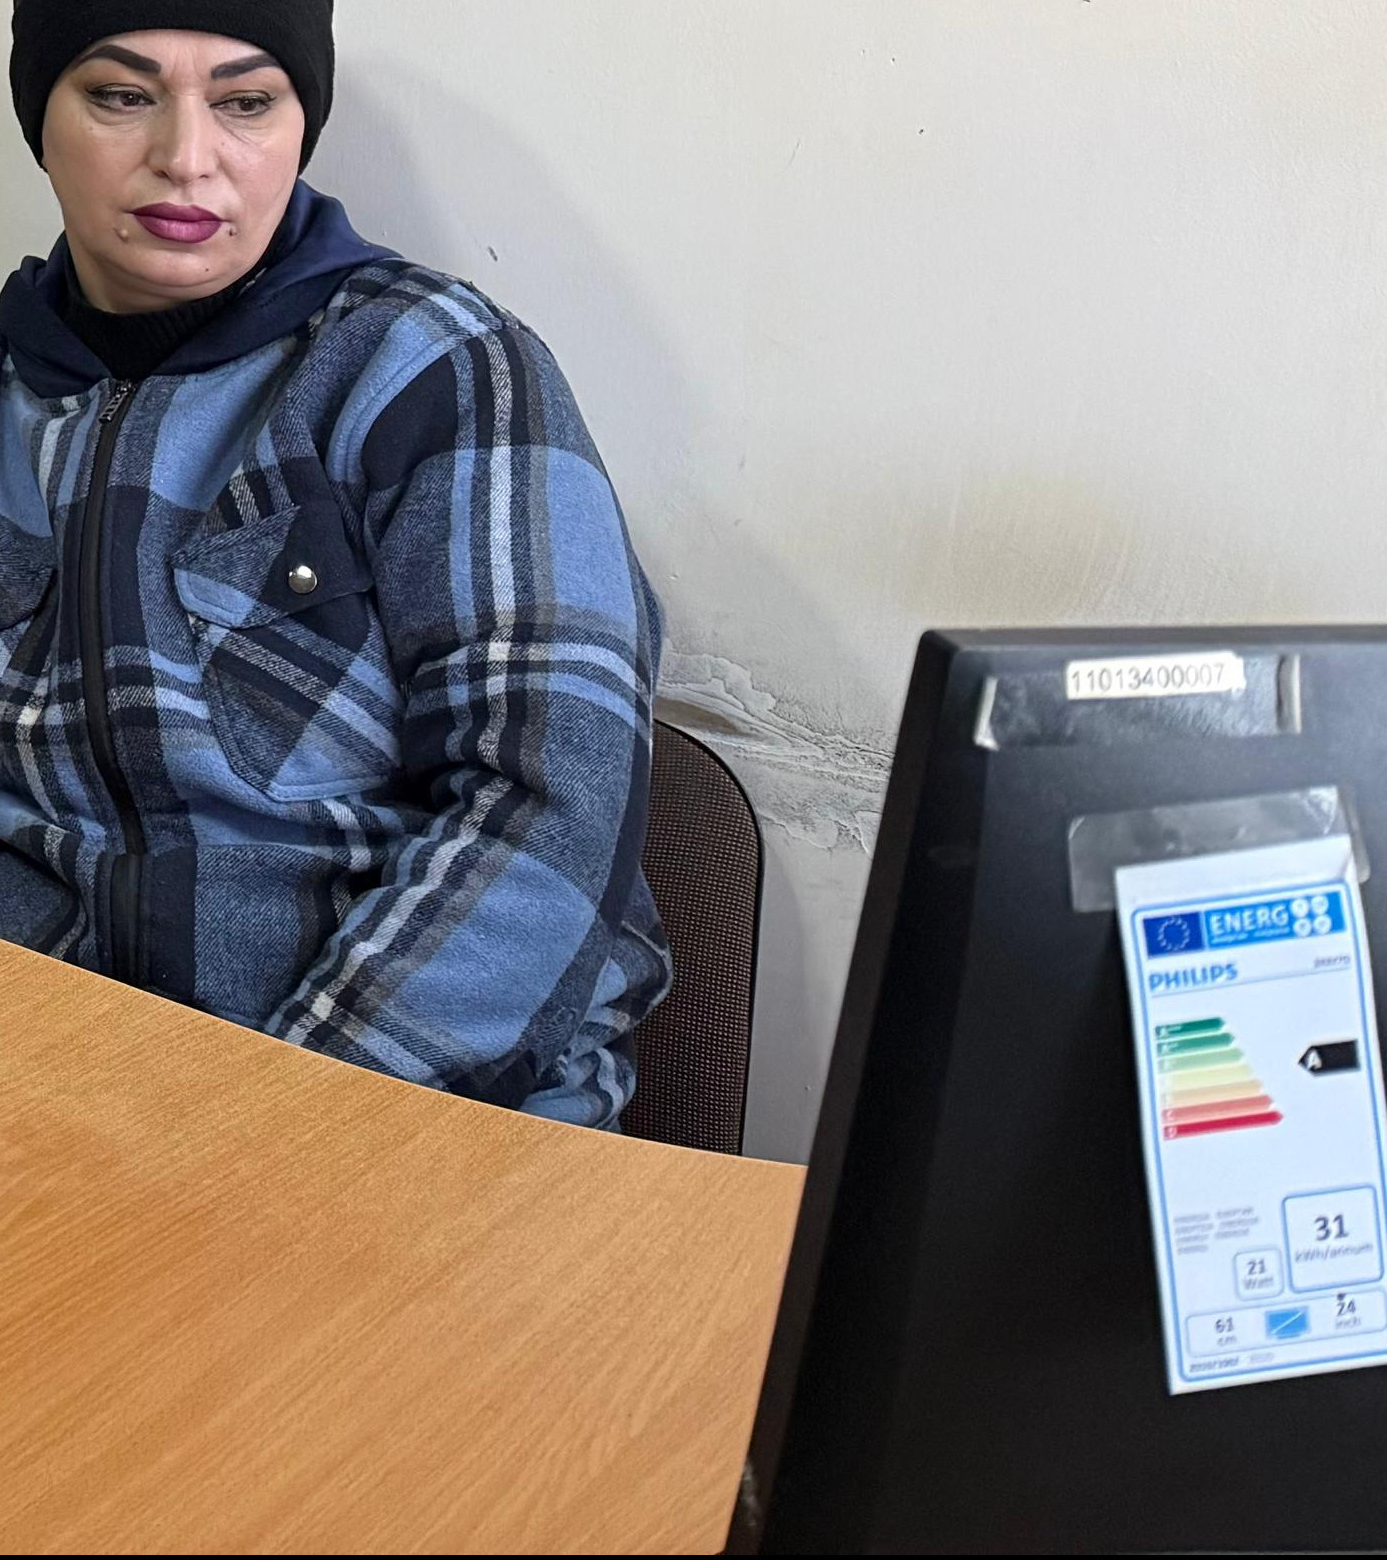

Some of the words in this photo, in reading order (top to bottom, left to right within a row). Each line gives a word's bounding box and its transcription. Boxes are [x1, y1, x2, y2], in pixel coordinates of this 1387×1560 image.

[1072, 663, 1225, 693] 11013400007
[1209, 904, 1290, 935] ENERG
[1148, 962, 1239, 991] PHILIPS
[1314, 1214, 1349, 1241] 31
[1247, 1260, 1266, 1275] 21
[1337, 1301, 1356, 1316] 24
